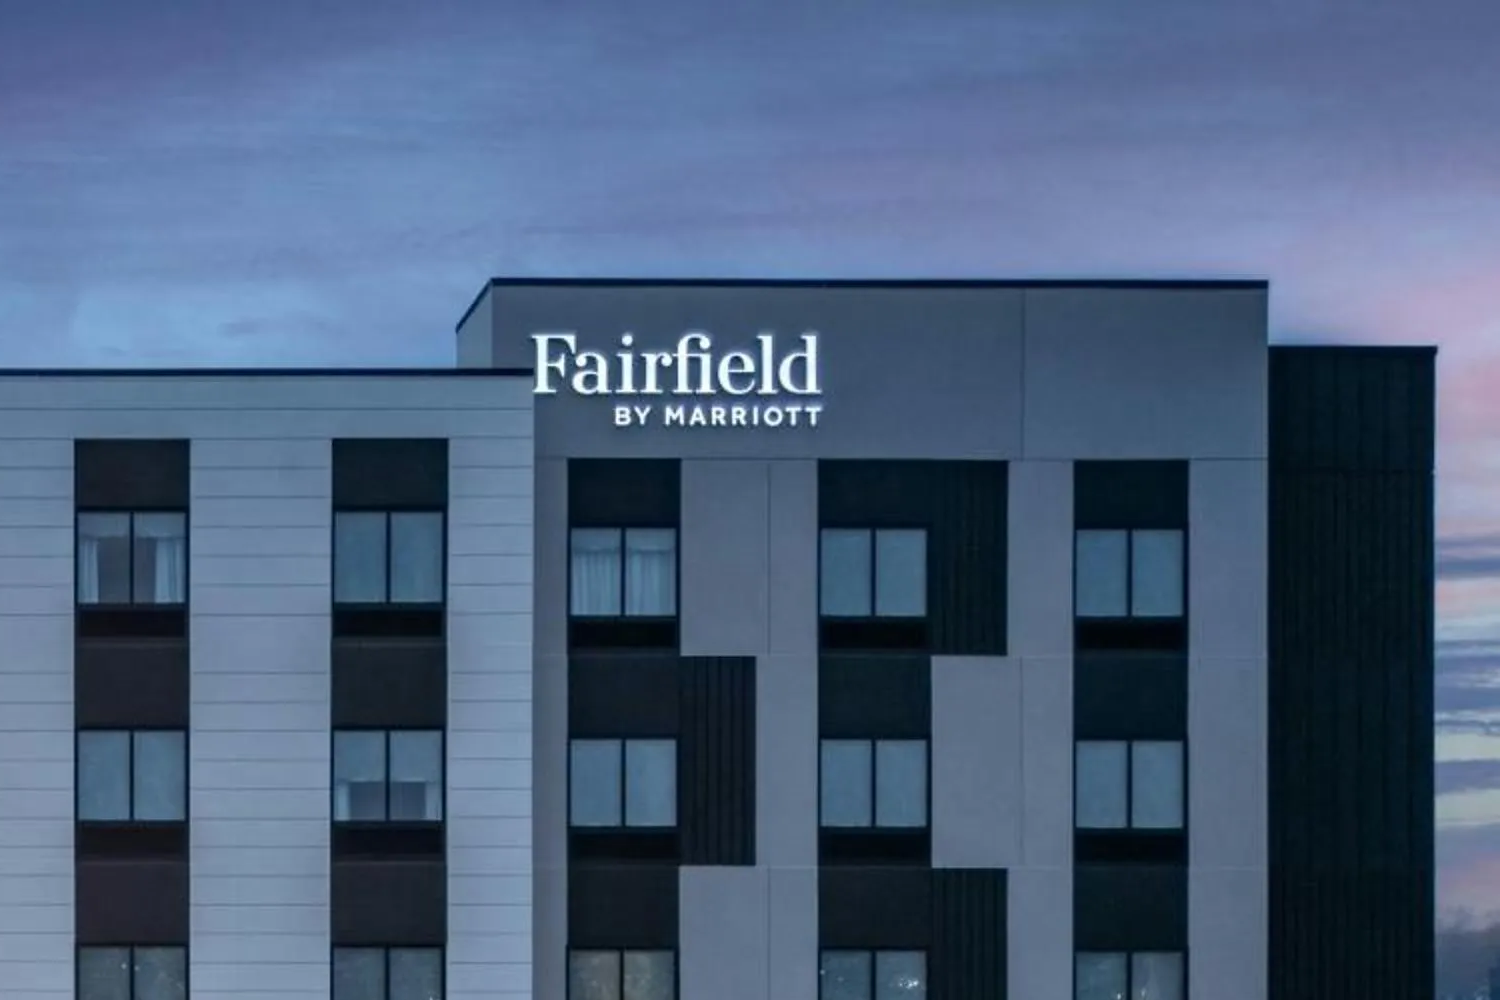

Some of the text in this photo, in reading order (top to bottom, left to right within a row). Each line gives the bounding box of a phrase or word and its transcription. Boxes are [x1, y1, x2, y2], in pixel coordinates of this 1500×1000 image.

[531, 333, 822, 395] Fairfield
[614, 405, 822, 426] BY MARRIOTT
